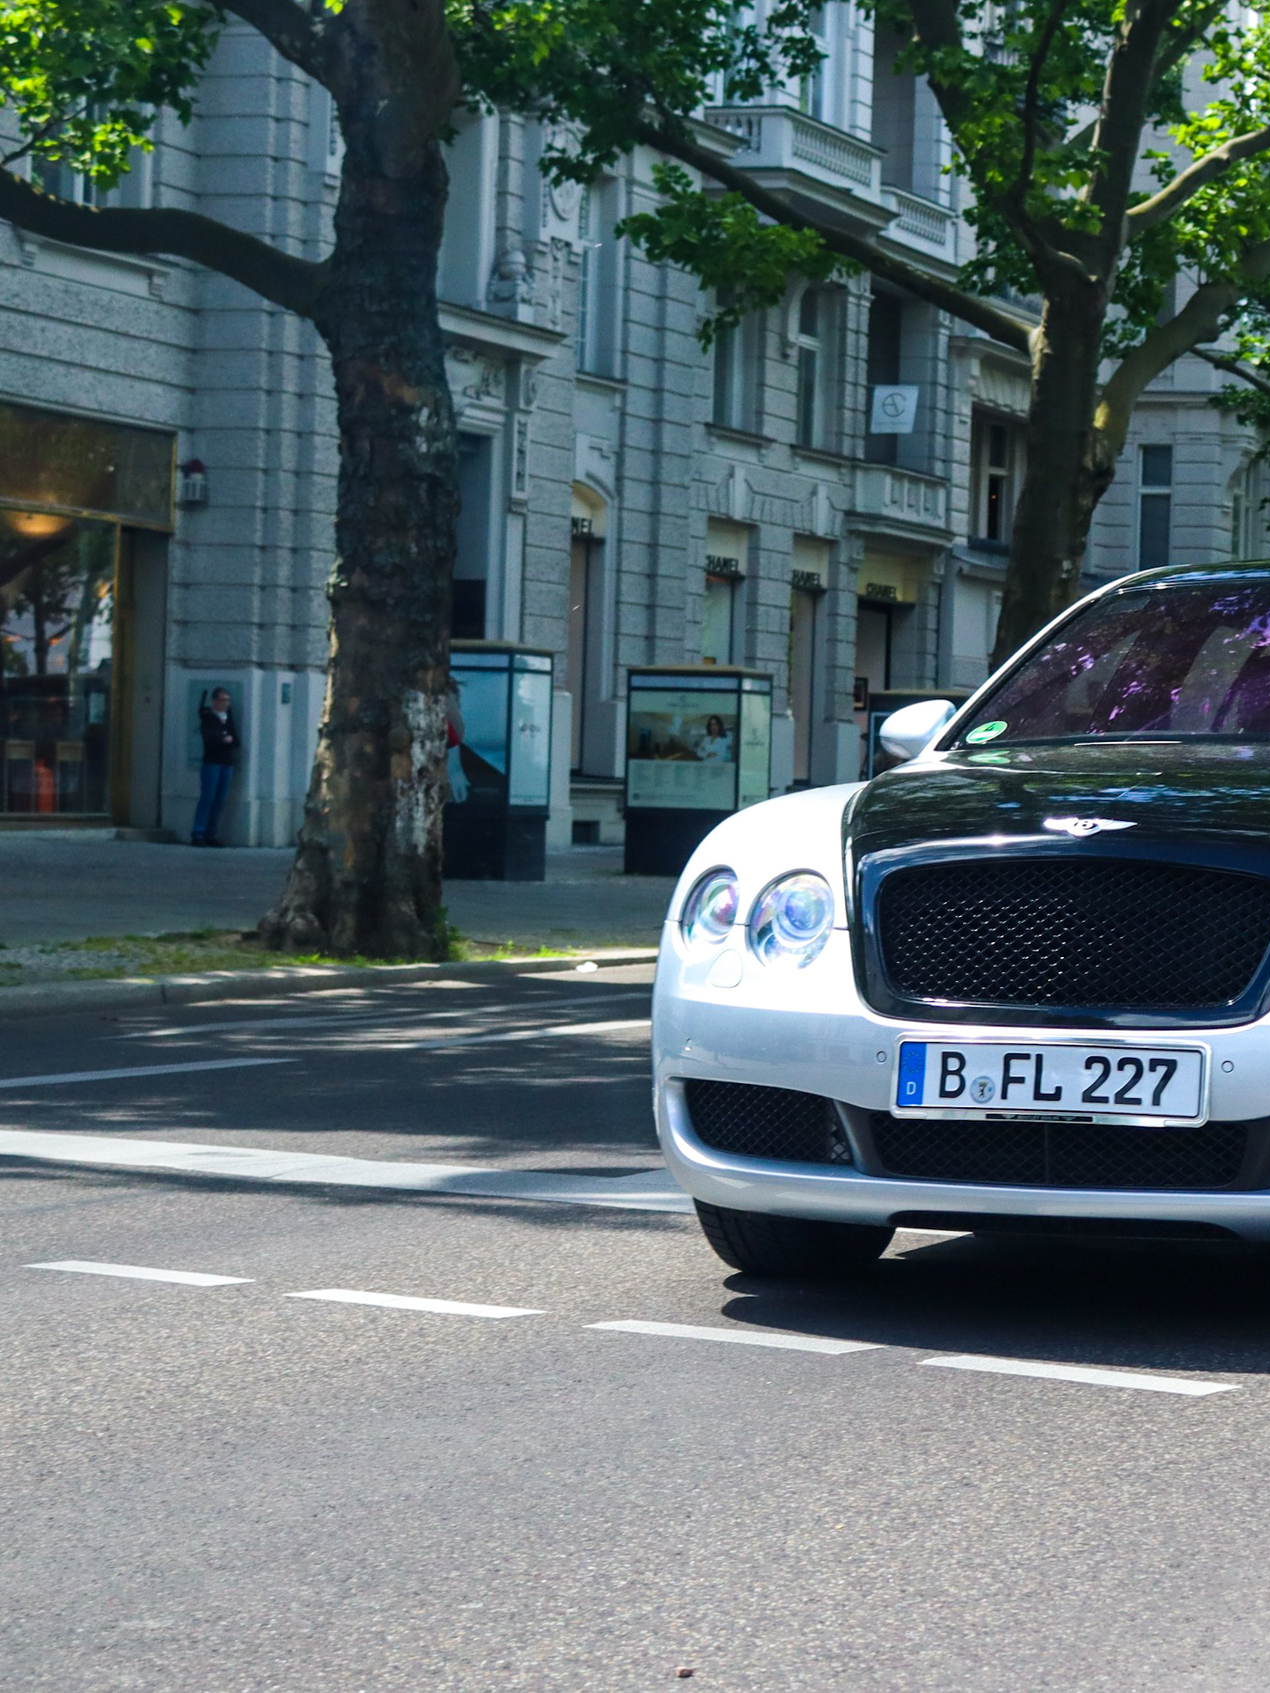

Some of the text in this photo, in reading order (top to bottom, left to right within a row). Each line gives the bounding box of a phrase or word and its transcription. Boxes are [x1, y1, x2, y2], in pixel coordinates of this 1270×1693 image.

[793, 569, 822, 589] HANEL
[905, 1081, 917, 1096] D
[938, 1051, 1178, 1107] B FL 227
